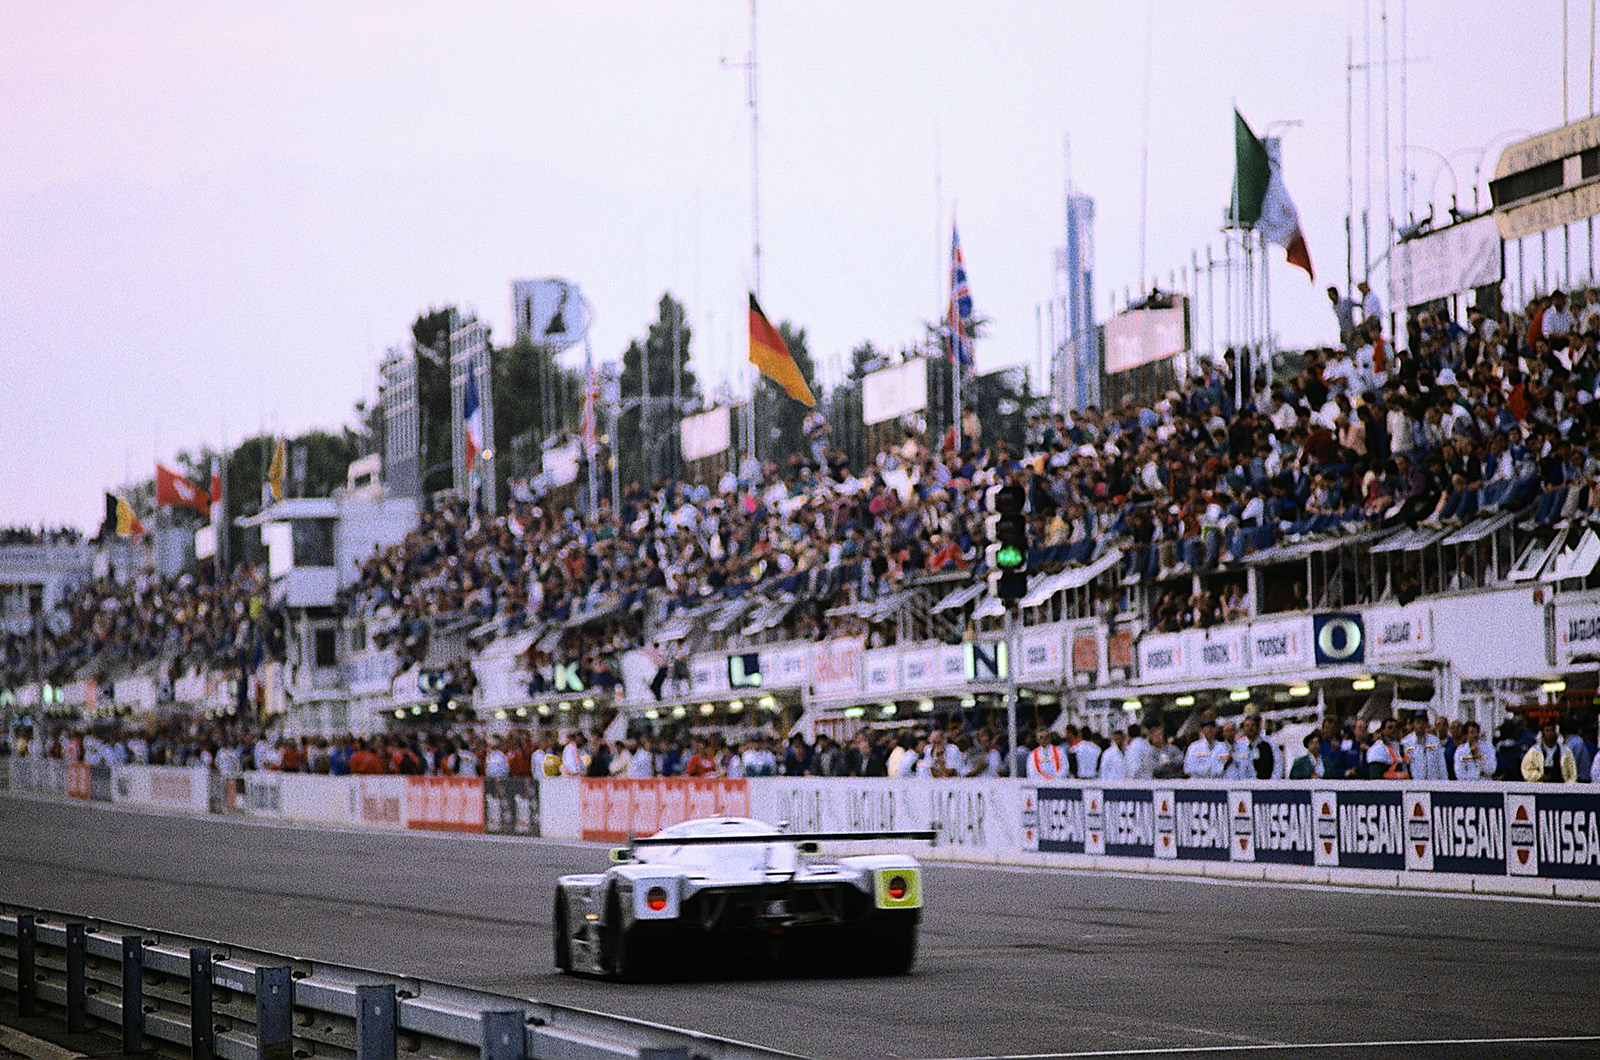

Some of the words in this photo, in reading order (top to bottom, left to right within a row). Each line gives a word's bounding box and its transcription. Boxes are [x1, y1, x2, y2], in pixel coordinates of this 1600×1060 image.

[1318, 618, 1361, 660] O
[553, 661, 584, 692] K
[730, 656, 762, 686] L
[963, 641, 1008, 681] N
[1253, 803, 1312, 852] NISSAN
[1339, 804, 1403, 855] NISSAN
[1433, 806, 1504, 860] NISSAN
